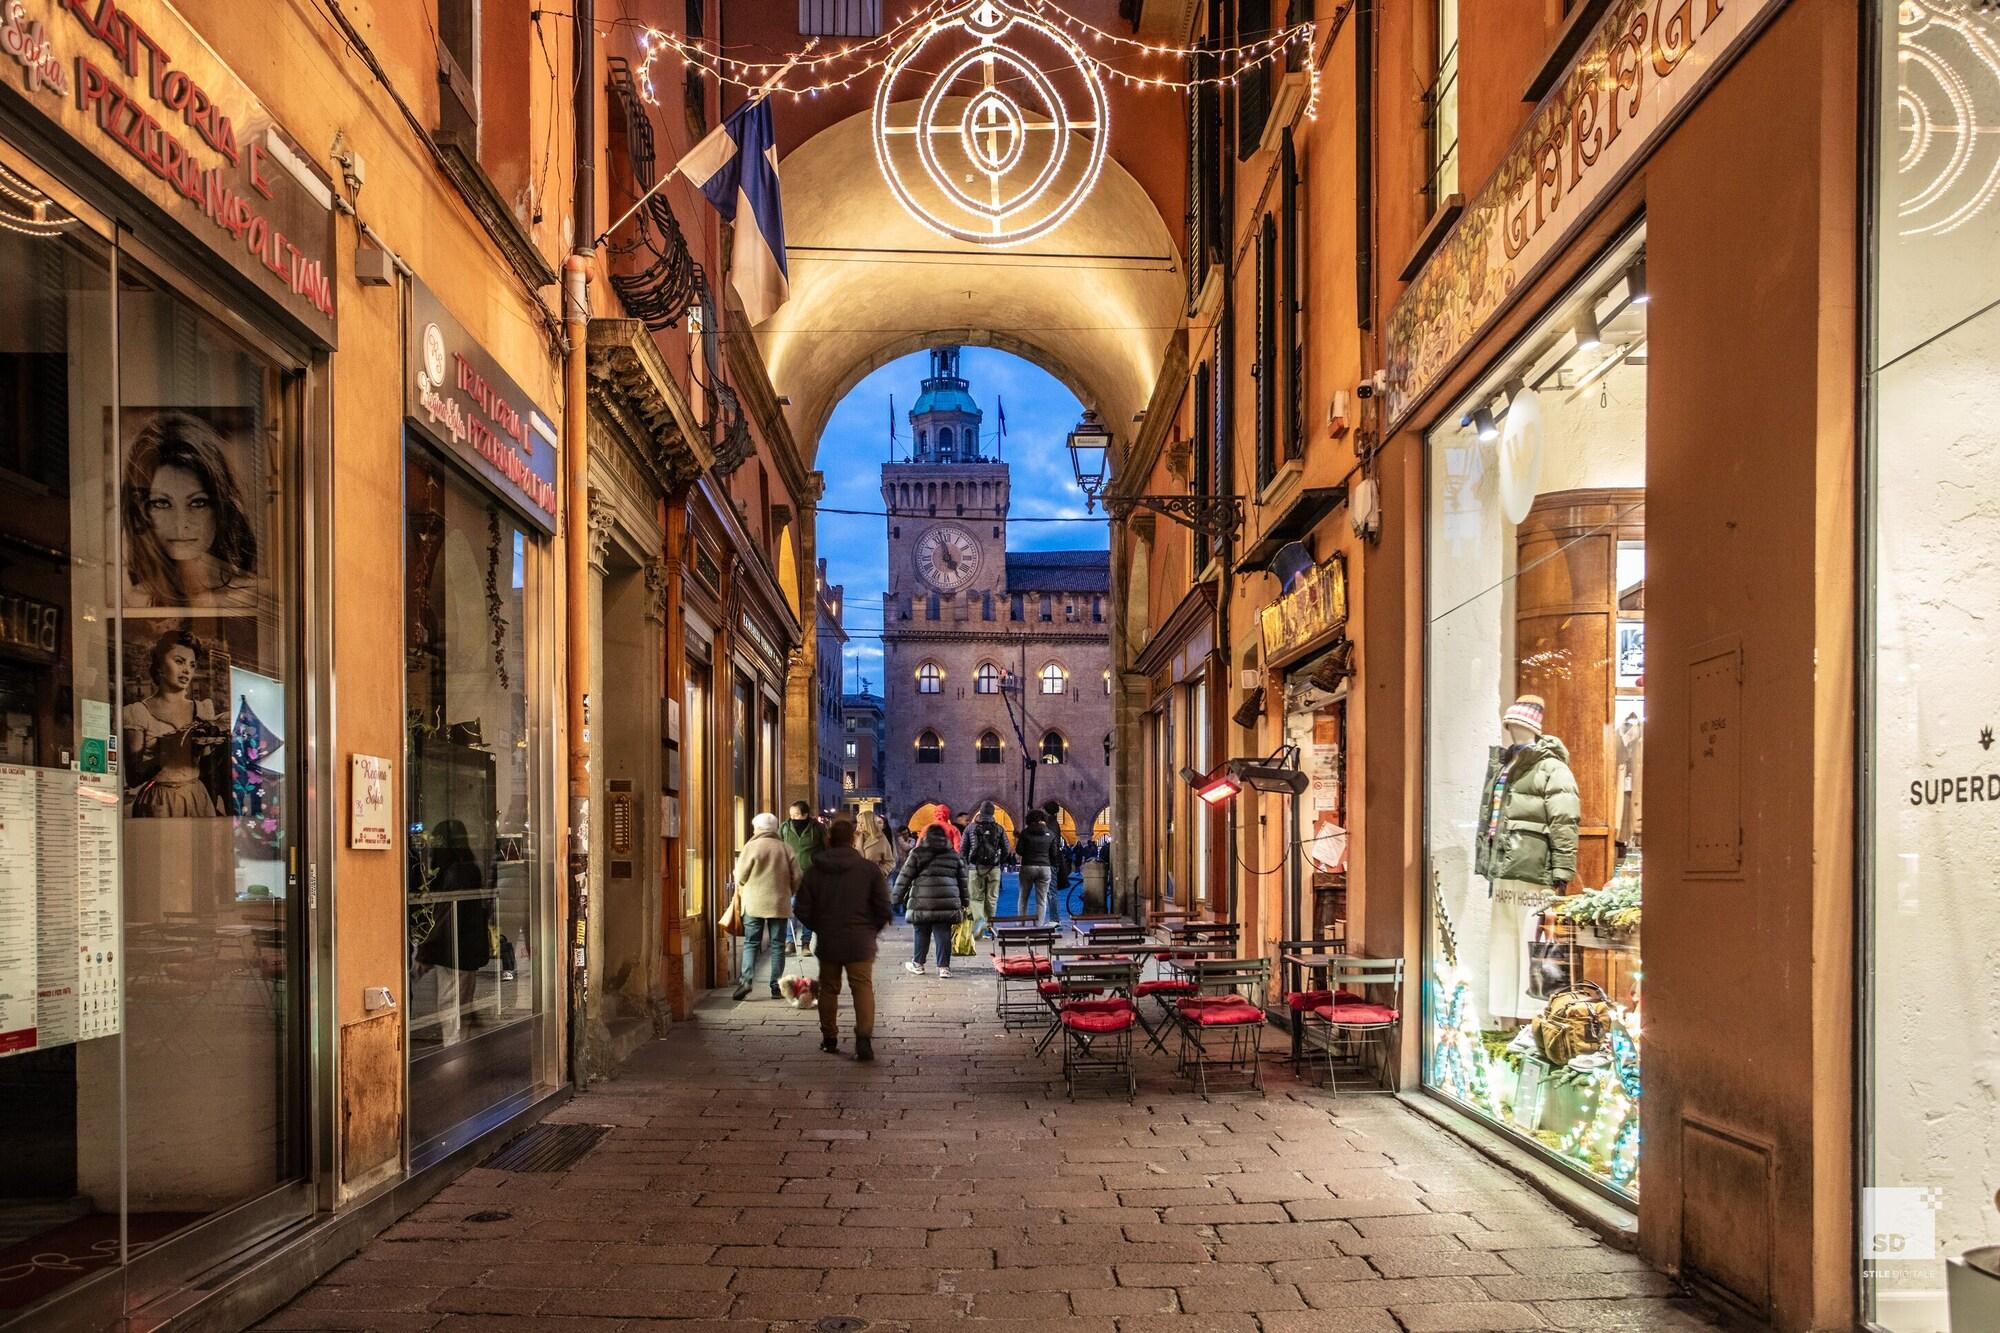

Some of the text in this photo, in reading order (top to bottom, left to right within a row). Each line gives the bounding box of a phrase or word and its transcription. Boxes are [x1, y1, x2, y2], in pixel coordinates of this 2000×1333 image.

[74, 56, 335, 320] PIZZERIA NAPOLETANA
[249, 143, 273, 200] E
[454, 352, 534, 456] TRATTORIA E
[467, 413, 510, 478] PIZZERIA
[1910, 774, 2000, 806] SUPERD
